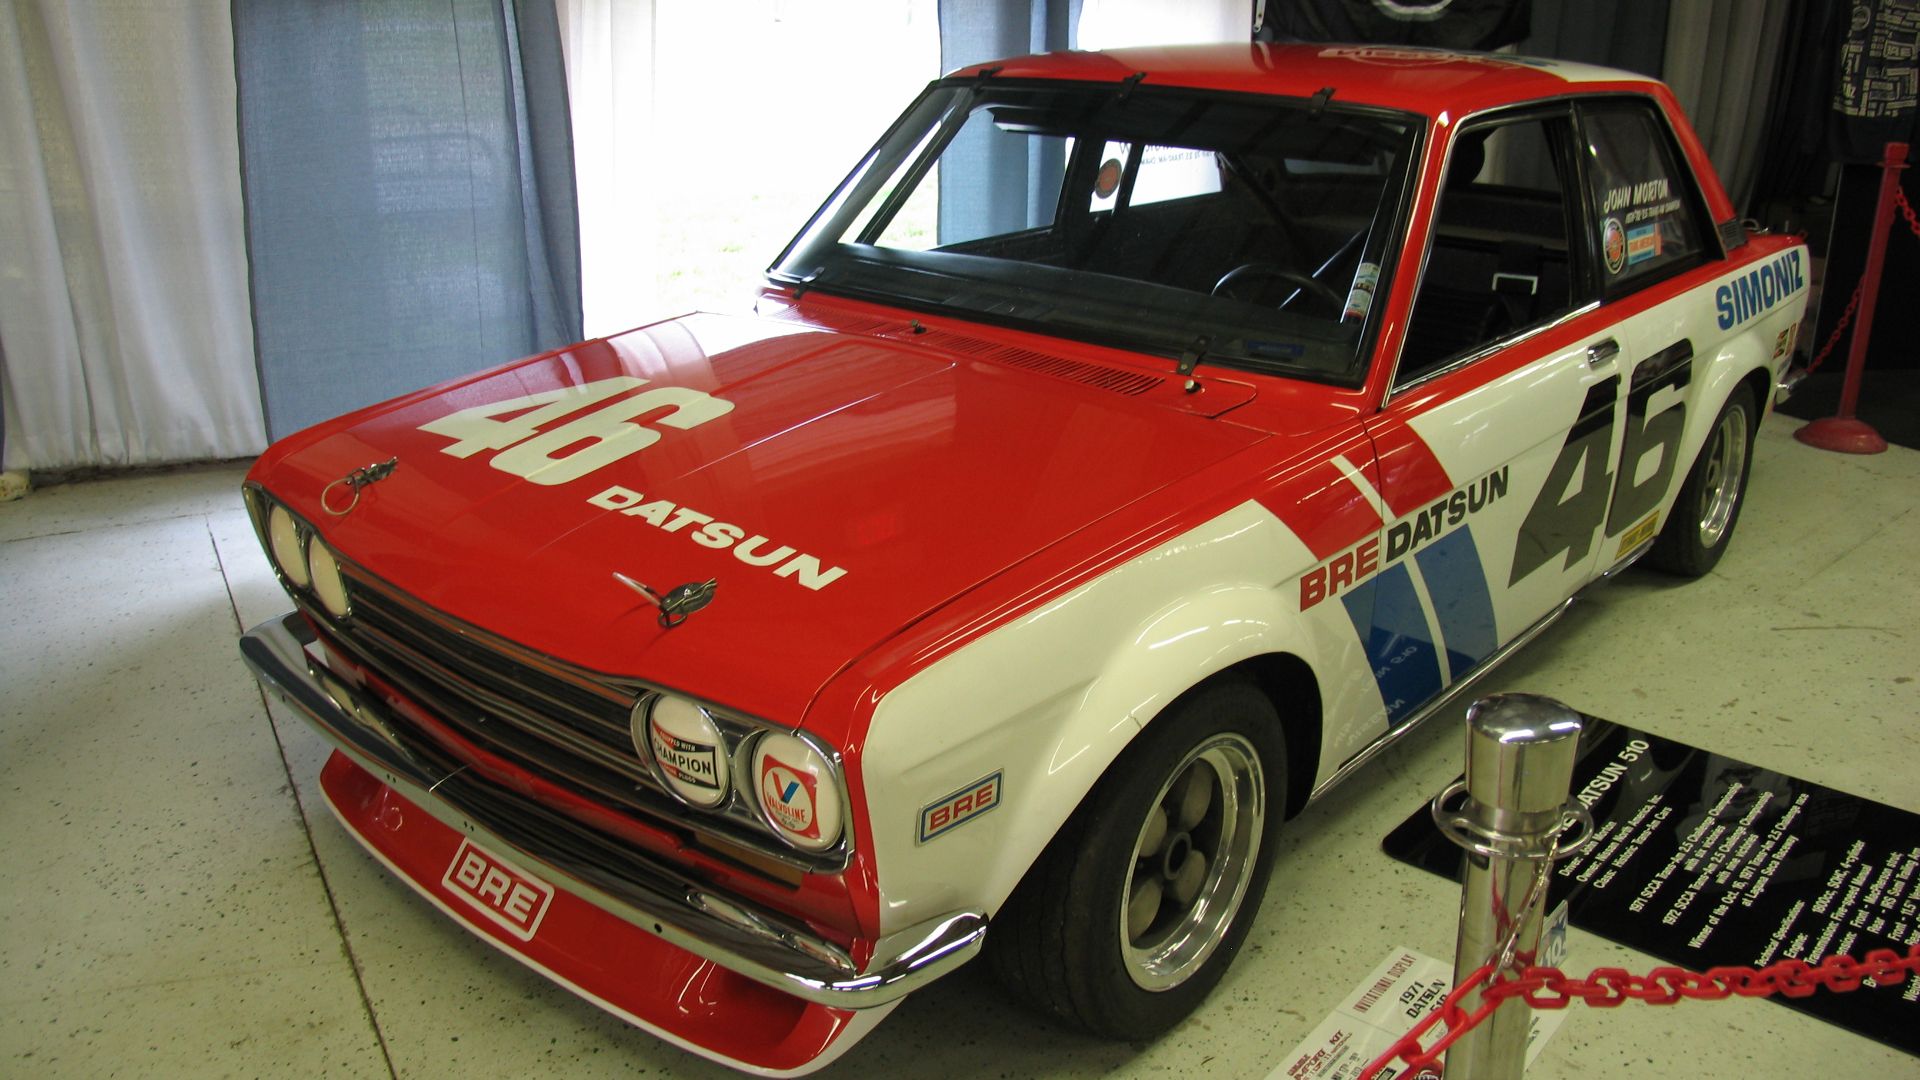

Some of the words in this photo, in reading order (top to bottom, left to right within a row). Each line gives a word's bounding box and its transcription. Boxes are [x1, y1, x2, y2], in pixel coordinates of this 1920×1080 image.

[1604, 186, 1631, 213] JOHN
[1633, 179, 1668, 205] MORTON
[1716, 250, 1803, 331] SIMONIZ
[416, 376, 735, 485] 46
[1508, 338, 1693, 589] 46
[587, 485, 848, 590] DATSUN
[1300, 537, 1379, 612] BRE
[1386, 466, 1508, 563] DATSUN
[929, 783, 993, 831] BRE
[1578, 762, 1628, 809] ATSUN
[1618, 739, 1650, 762] 510
[456, 851, 538, 923] BRE
[1353, 976, 1395, 1013] INVITATIONAL
[1387, 954, 1417, 978] DISPLAY
[1400, 981, 1424, 1005] 1971
[1406, 979, 1446, 1019] DATSUN
[1329, 1030, 1344, 1046] KIT
